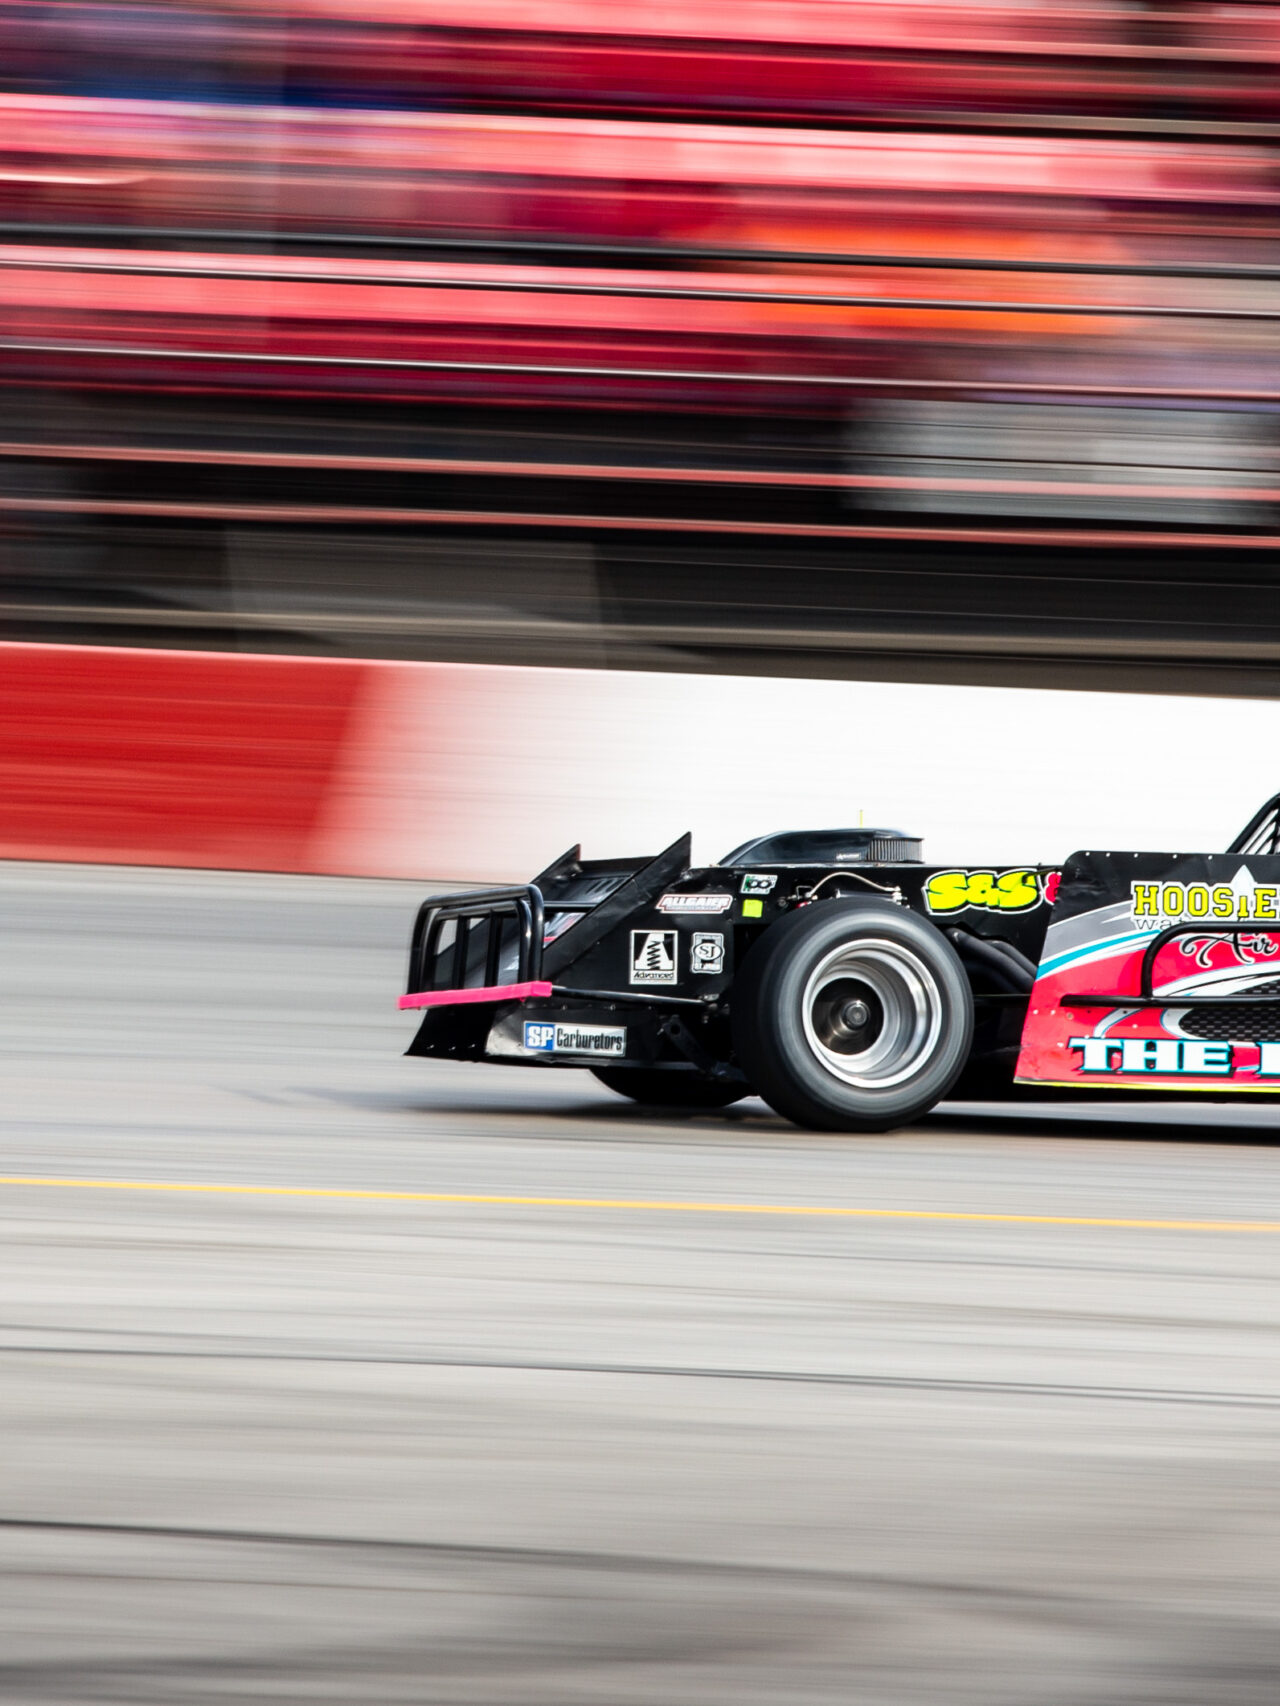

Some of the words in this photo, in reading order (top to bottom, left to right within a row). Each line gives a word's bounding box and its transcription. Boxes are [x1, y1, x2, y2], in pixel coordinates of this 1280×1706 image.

[927, 871, 1040, 913] S&S
[527, 1025, 554, 1048] SP
[556, 1027, 622, 1051] Carburetors
[1069, 1038, 1232, 1075] THE
